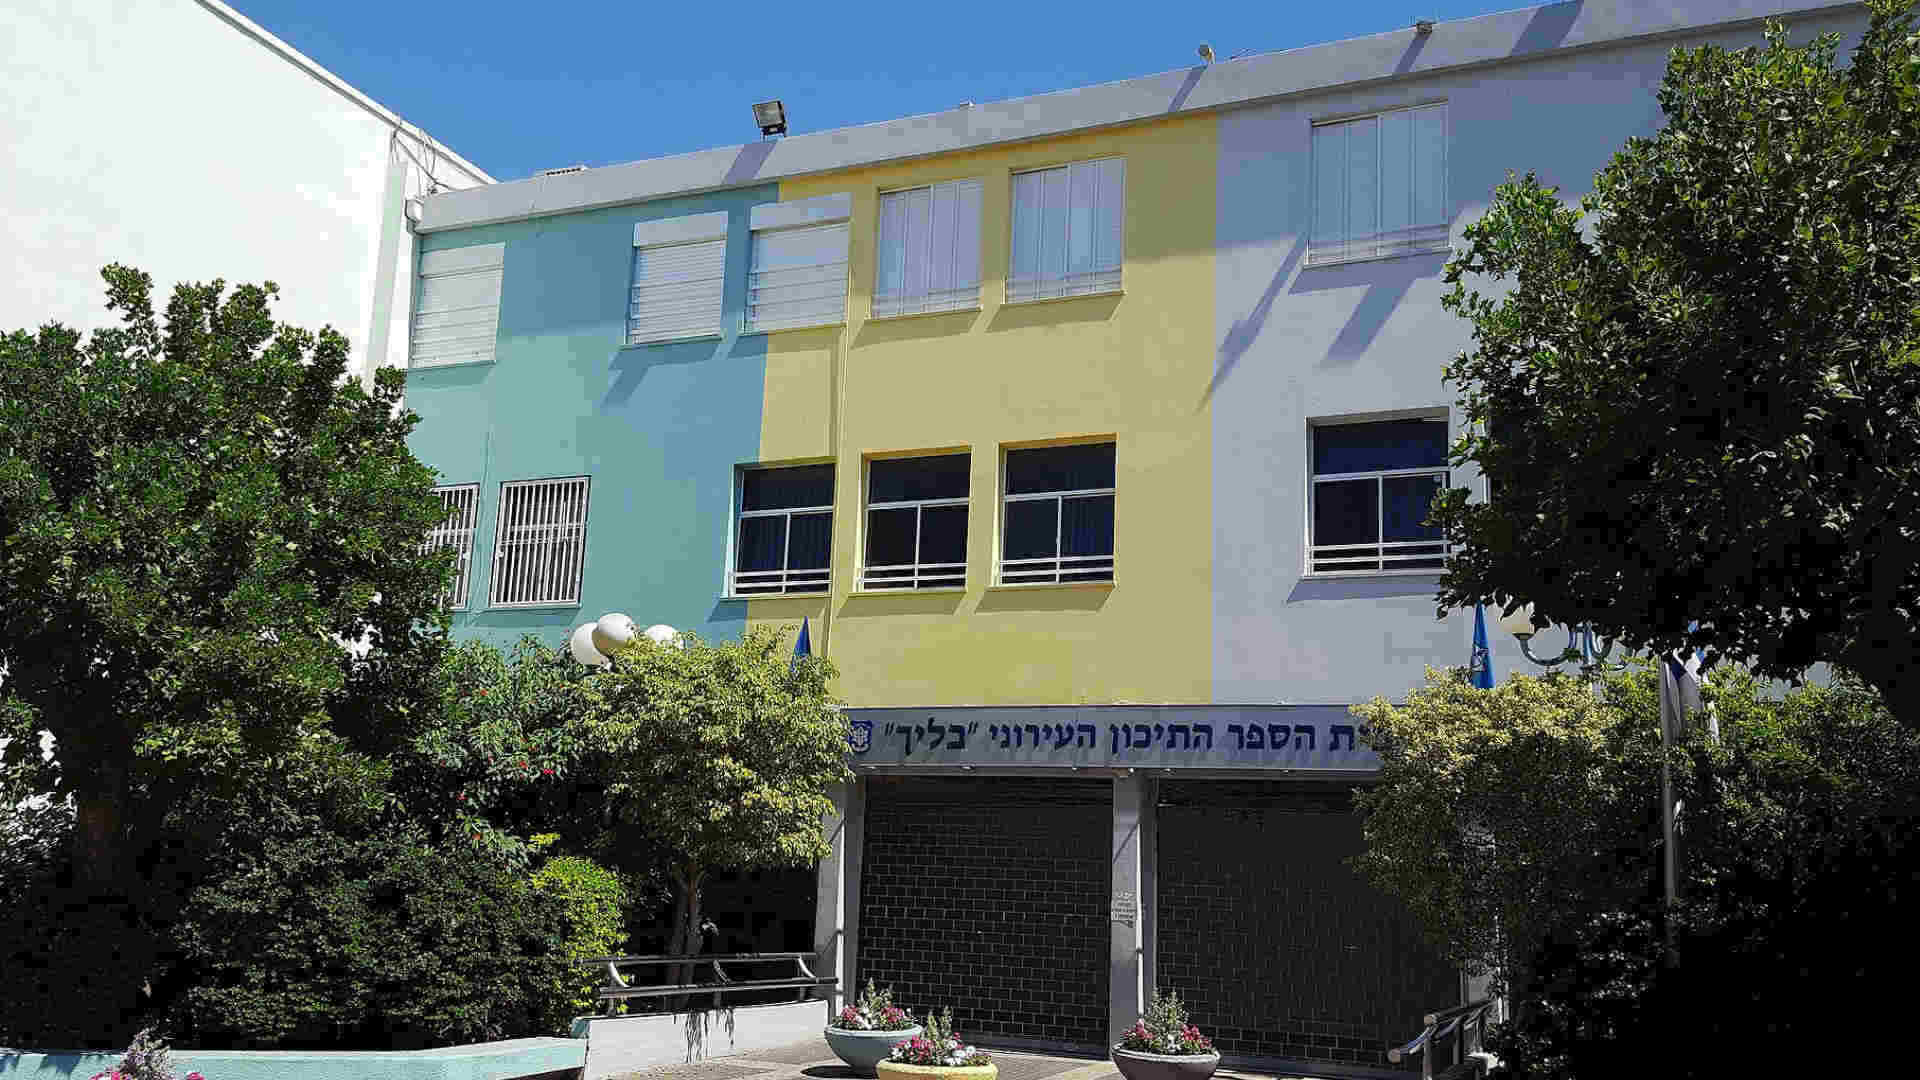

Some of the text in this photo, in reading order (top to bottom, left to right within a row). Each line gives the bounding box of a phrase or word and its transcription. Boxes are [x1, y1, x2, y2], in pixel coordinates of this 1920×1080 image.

[989, 723, 1097, 751] העירוני
[1109, 722, 1214, 754] התיכון
[1227, 723, 1316, 751] הספר
[1329, 724, 1376, 752] ית
